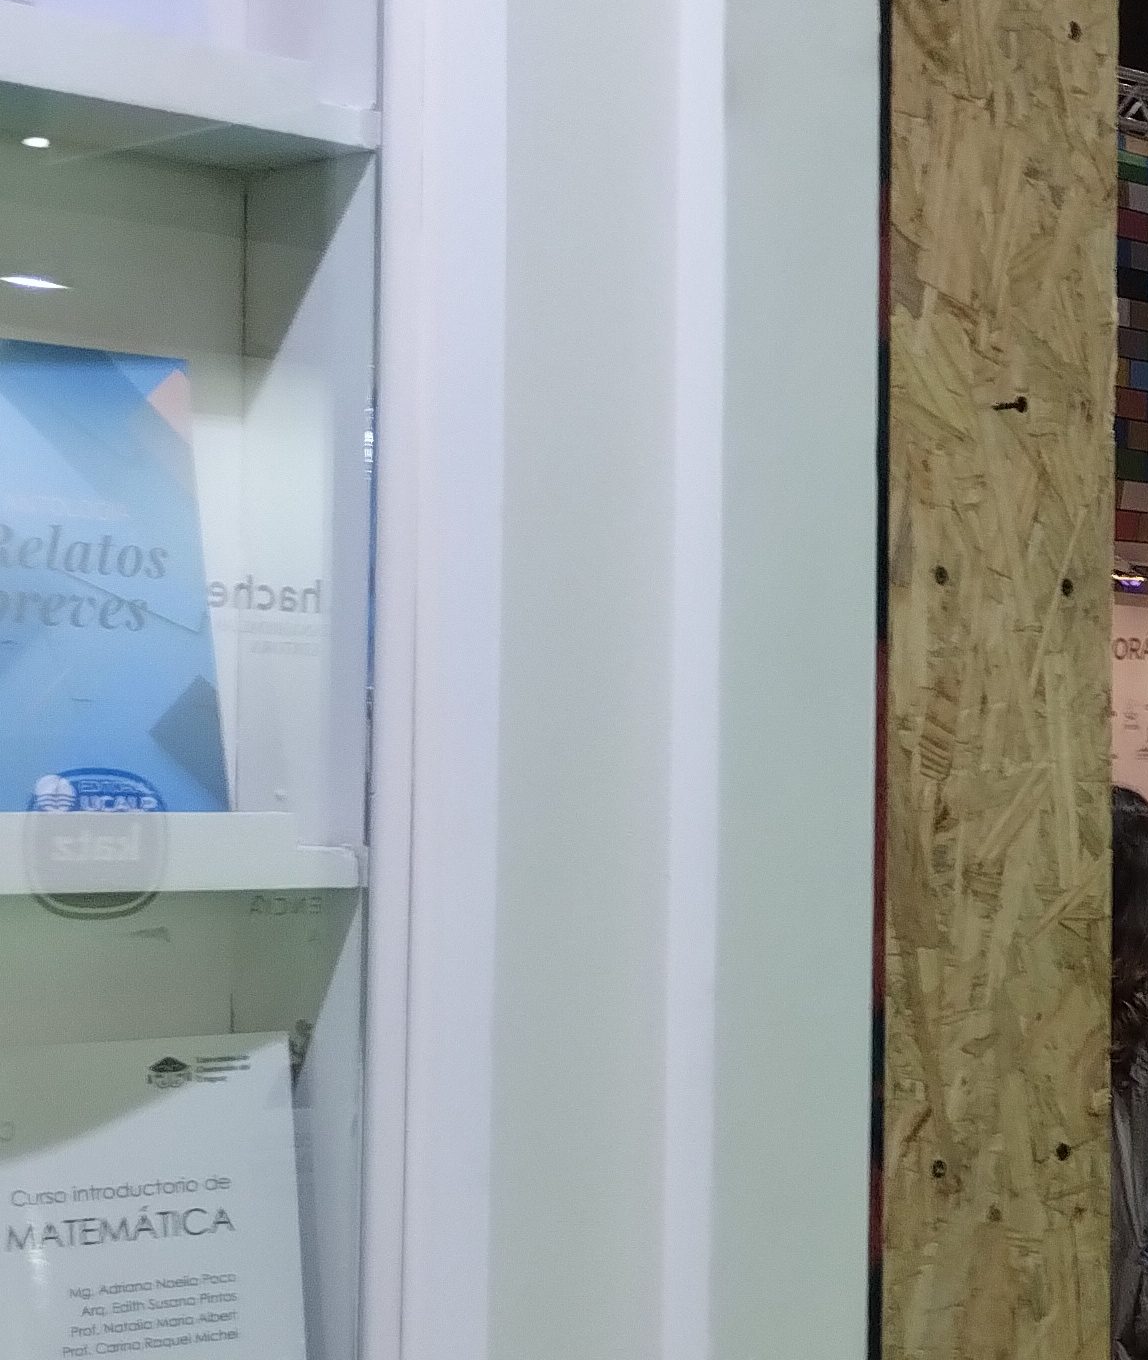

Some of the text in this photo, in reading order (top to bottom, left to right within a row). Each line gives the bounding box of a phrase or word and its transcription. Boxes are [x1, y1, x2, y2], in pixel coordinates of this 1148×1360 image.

[10, 1175, 233, 1207] Curso introductorio de
[4, 1205, 237, 1253] MATEMÁTICA
